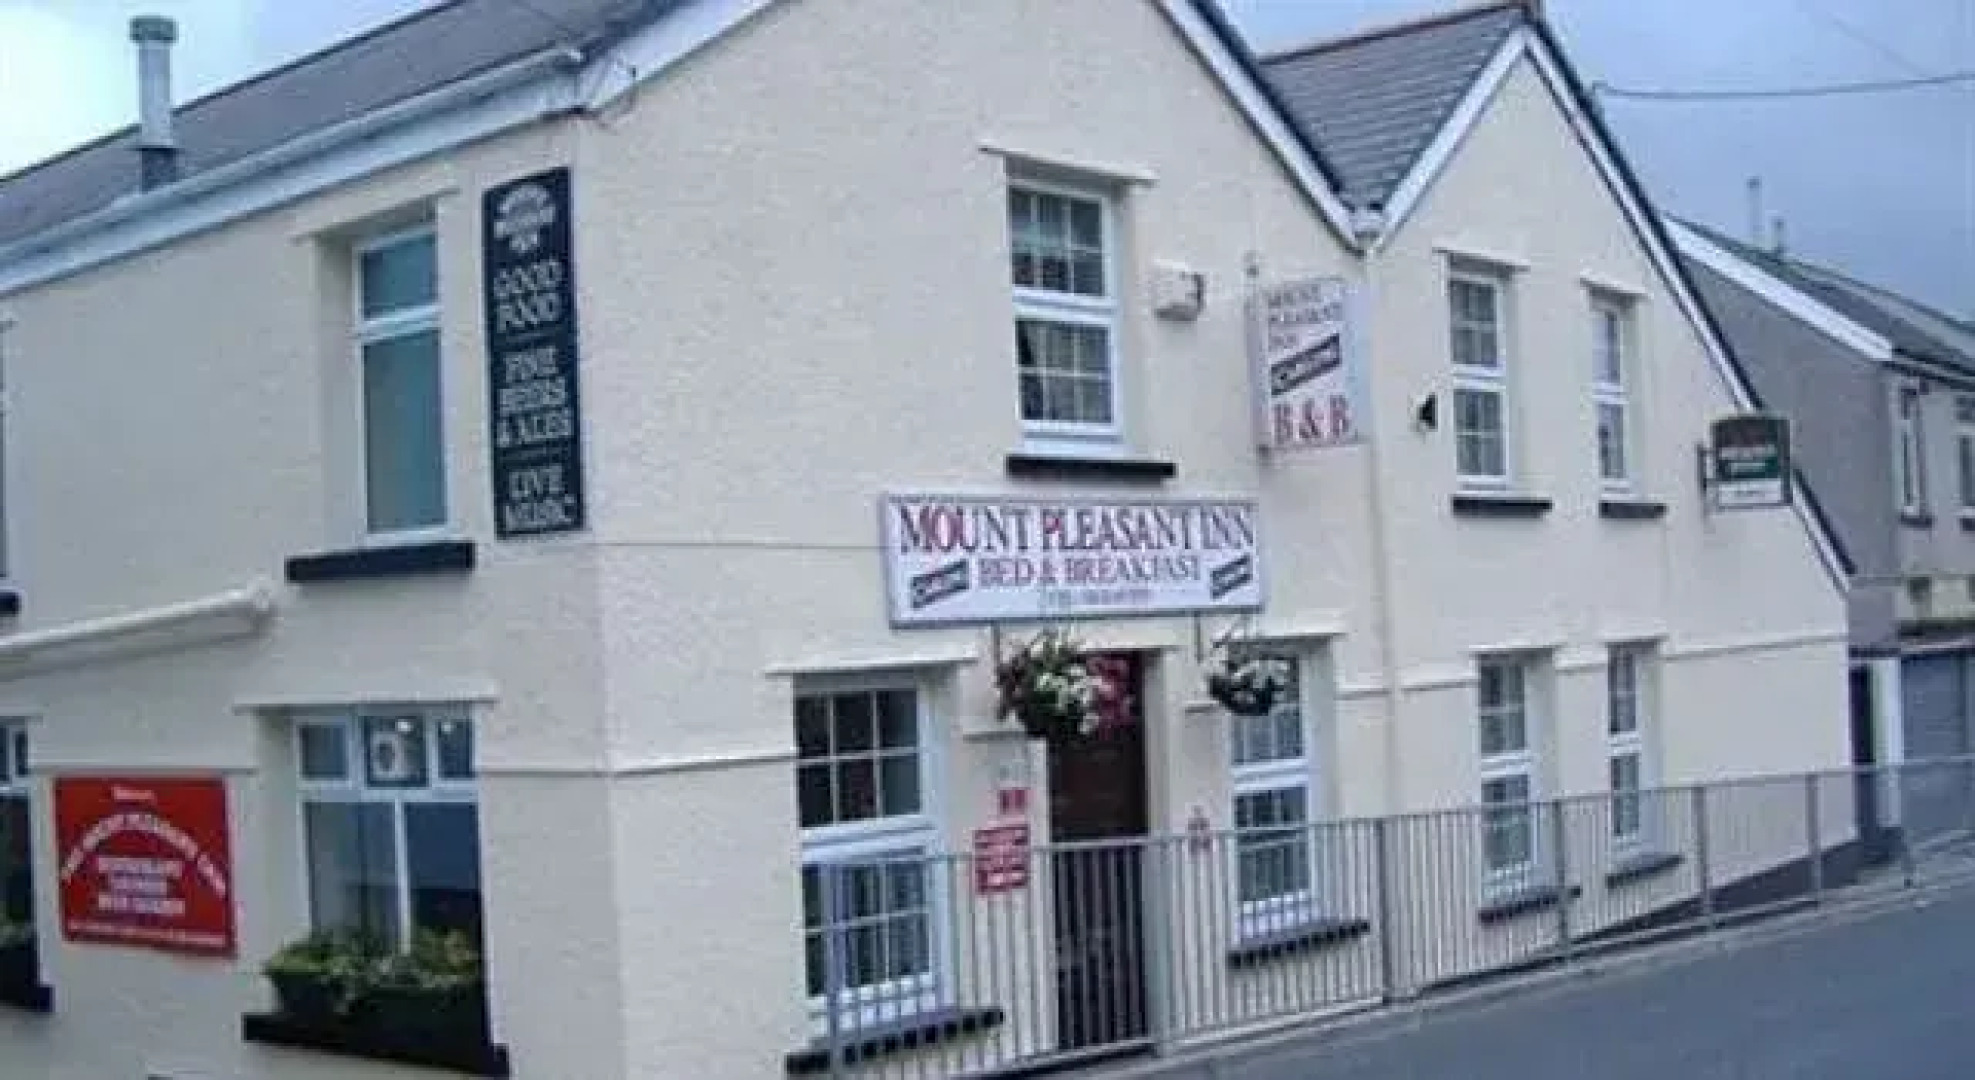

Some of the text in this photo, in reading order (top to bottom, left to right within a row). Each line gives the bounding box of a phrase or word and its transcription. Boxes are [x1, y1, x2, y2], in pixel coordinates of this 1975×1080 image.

[494, 258, 564, 298] GOOD
[496, 292, 562, 334] FOOD
[504, 347, 558, 384] FINE
[515, 406, 573, 442] ALES
[1273, 393, 1350, 444] B & B
[508, 464, 564, 501] LIVE
[900, 503, 1254, 554] MOUNT PLEASANT INN
[978, 557, 1035, 587] BED
[1041, 557, 1057, 584] &
[1063, 553, 1201, 584] BREAKFAST
